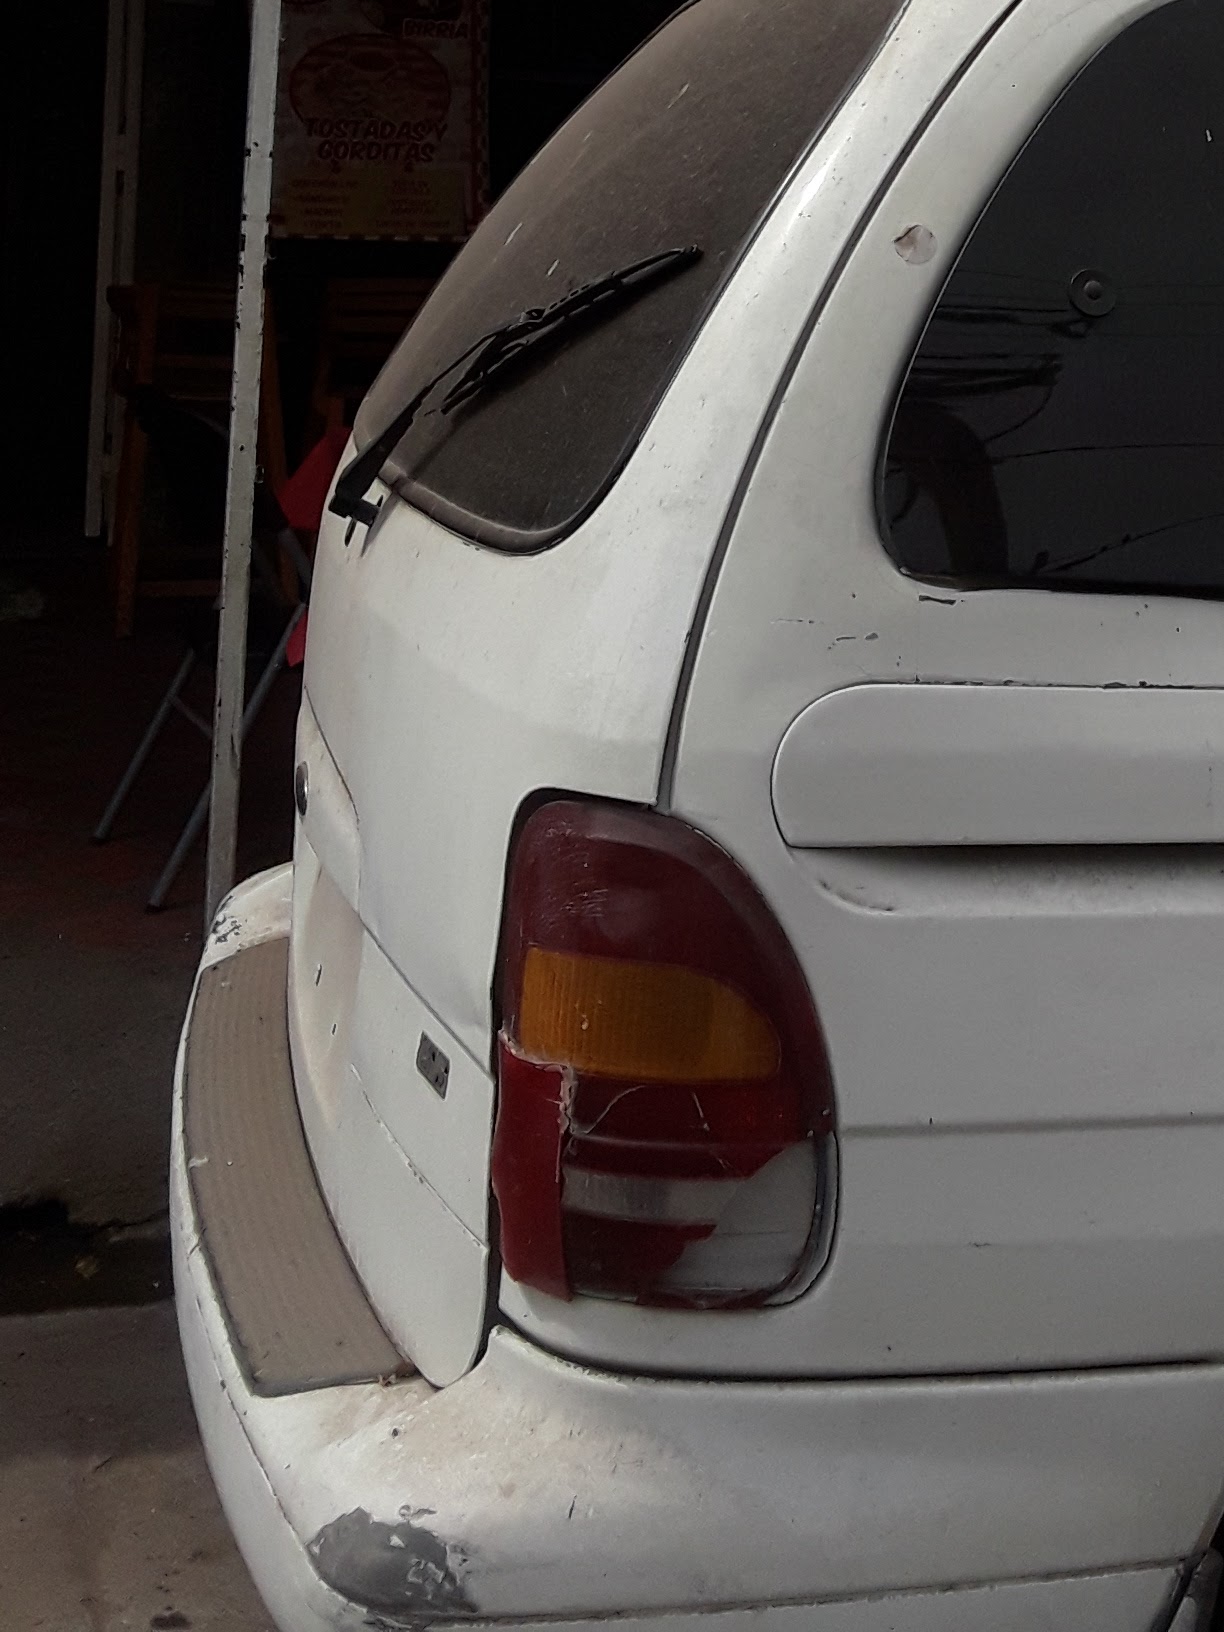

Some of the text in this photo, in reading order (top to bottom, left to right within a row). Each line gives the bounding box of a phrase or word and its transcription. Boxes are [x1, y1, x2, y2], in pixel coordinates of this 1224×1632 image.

[403, 21, 469, 39] BIRRIA
[306, 118, 426, 140] TOSTADAS
[317, 140, 436, 163] GORDITAS
